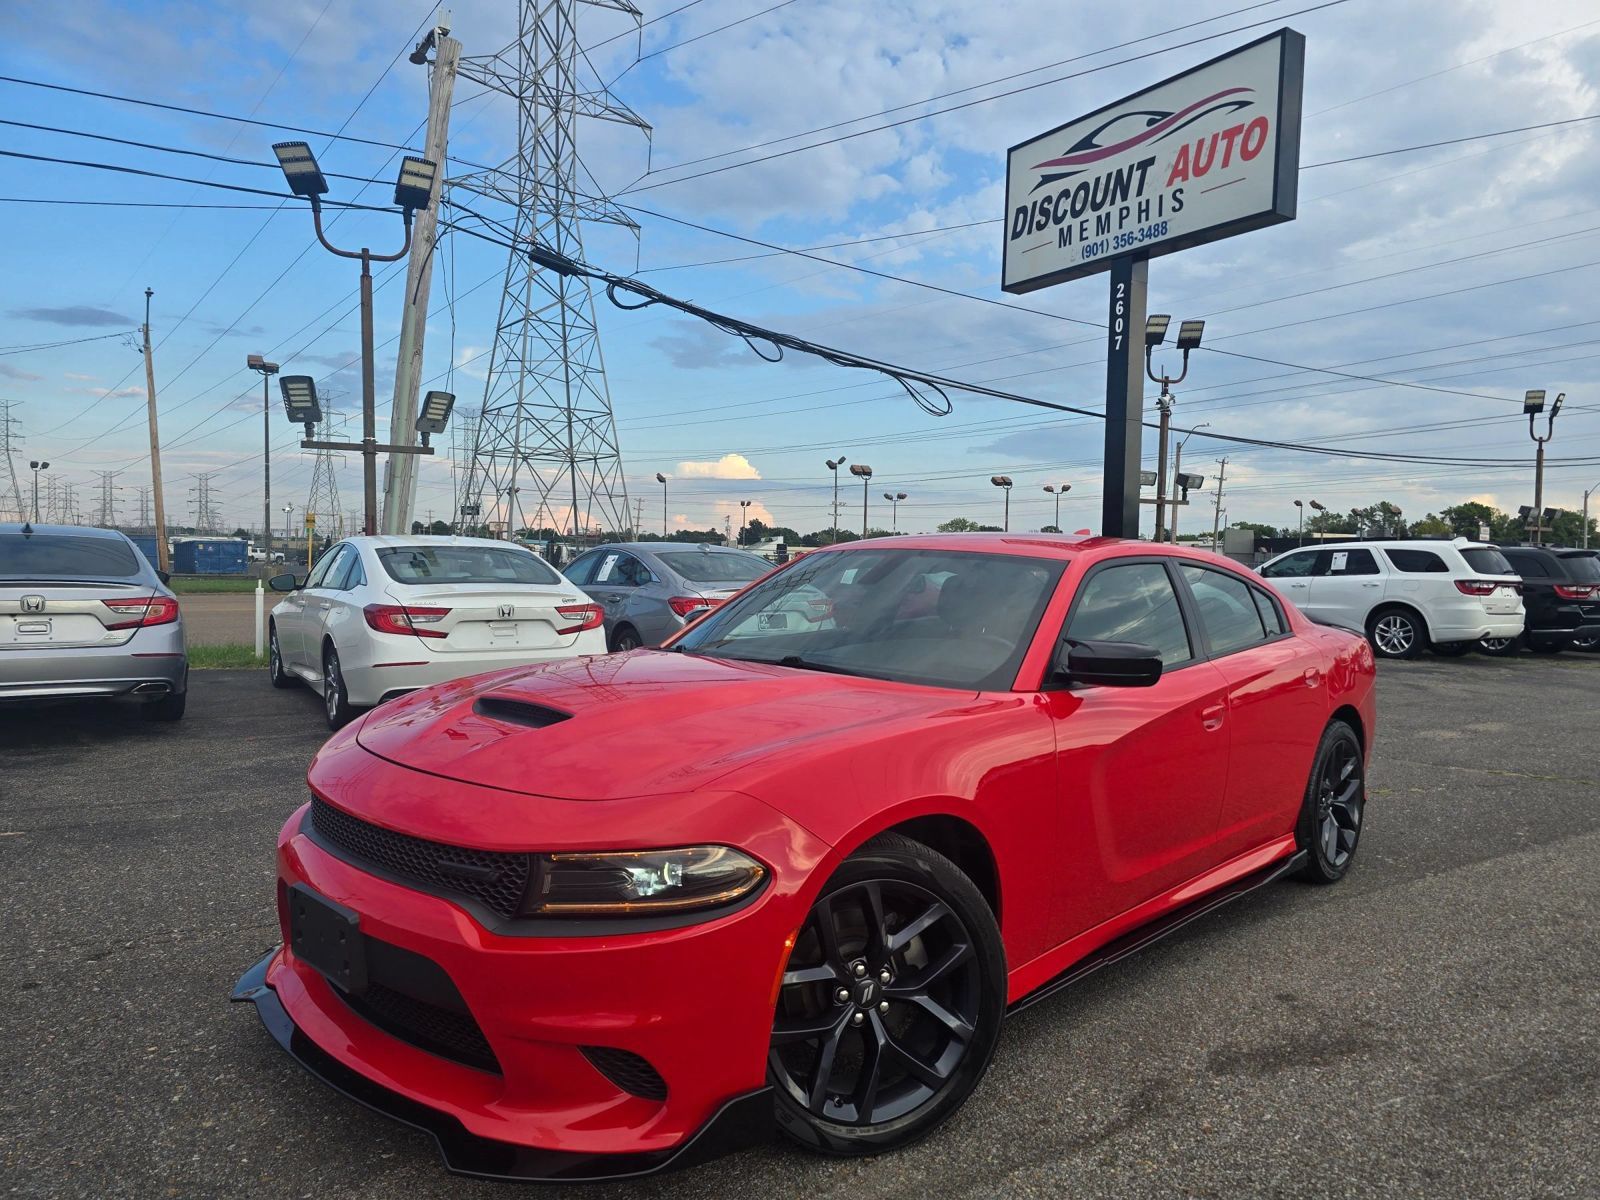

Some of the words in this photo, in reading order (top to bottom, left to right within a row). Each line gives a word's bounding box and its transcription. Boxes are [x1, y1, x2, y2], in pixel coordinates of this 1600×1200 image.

[1011, 156, 1156, 241] DISCOUNT
[1166, 116, 1269, 187] AUTO
[1058, 188, 1184, 248] MEMPHIS
[1081, 239, 1109, 260] (901)
[1113, 221, 1168, 250] 356-3488
[1115, 283, 1125, 350] 2607
